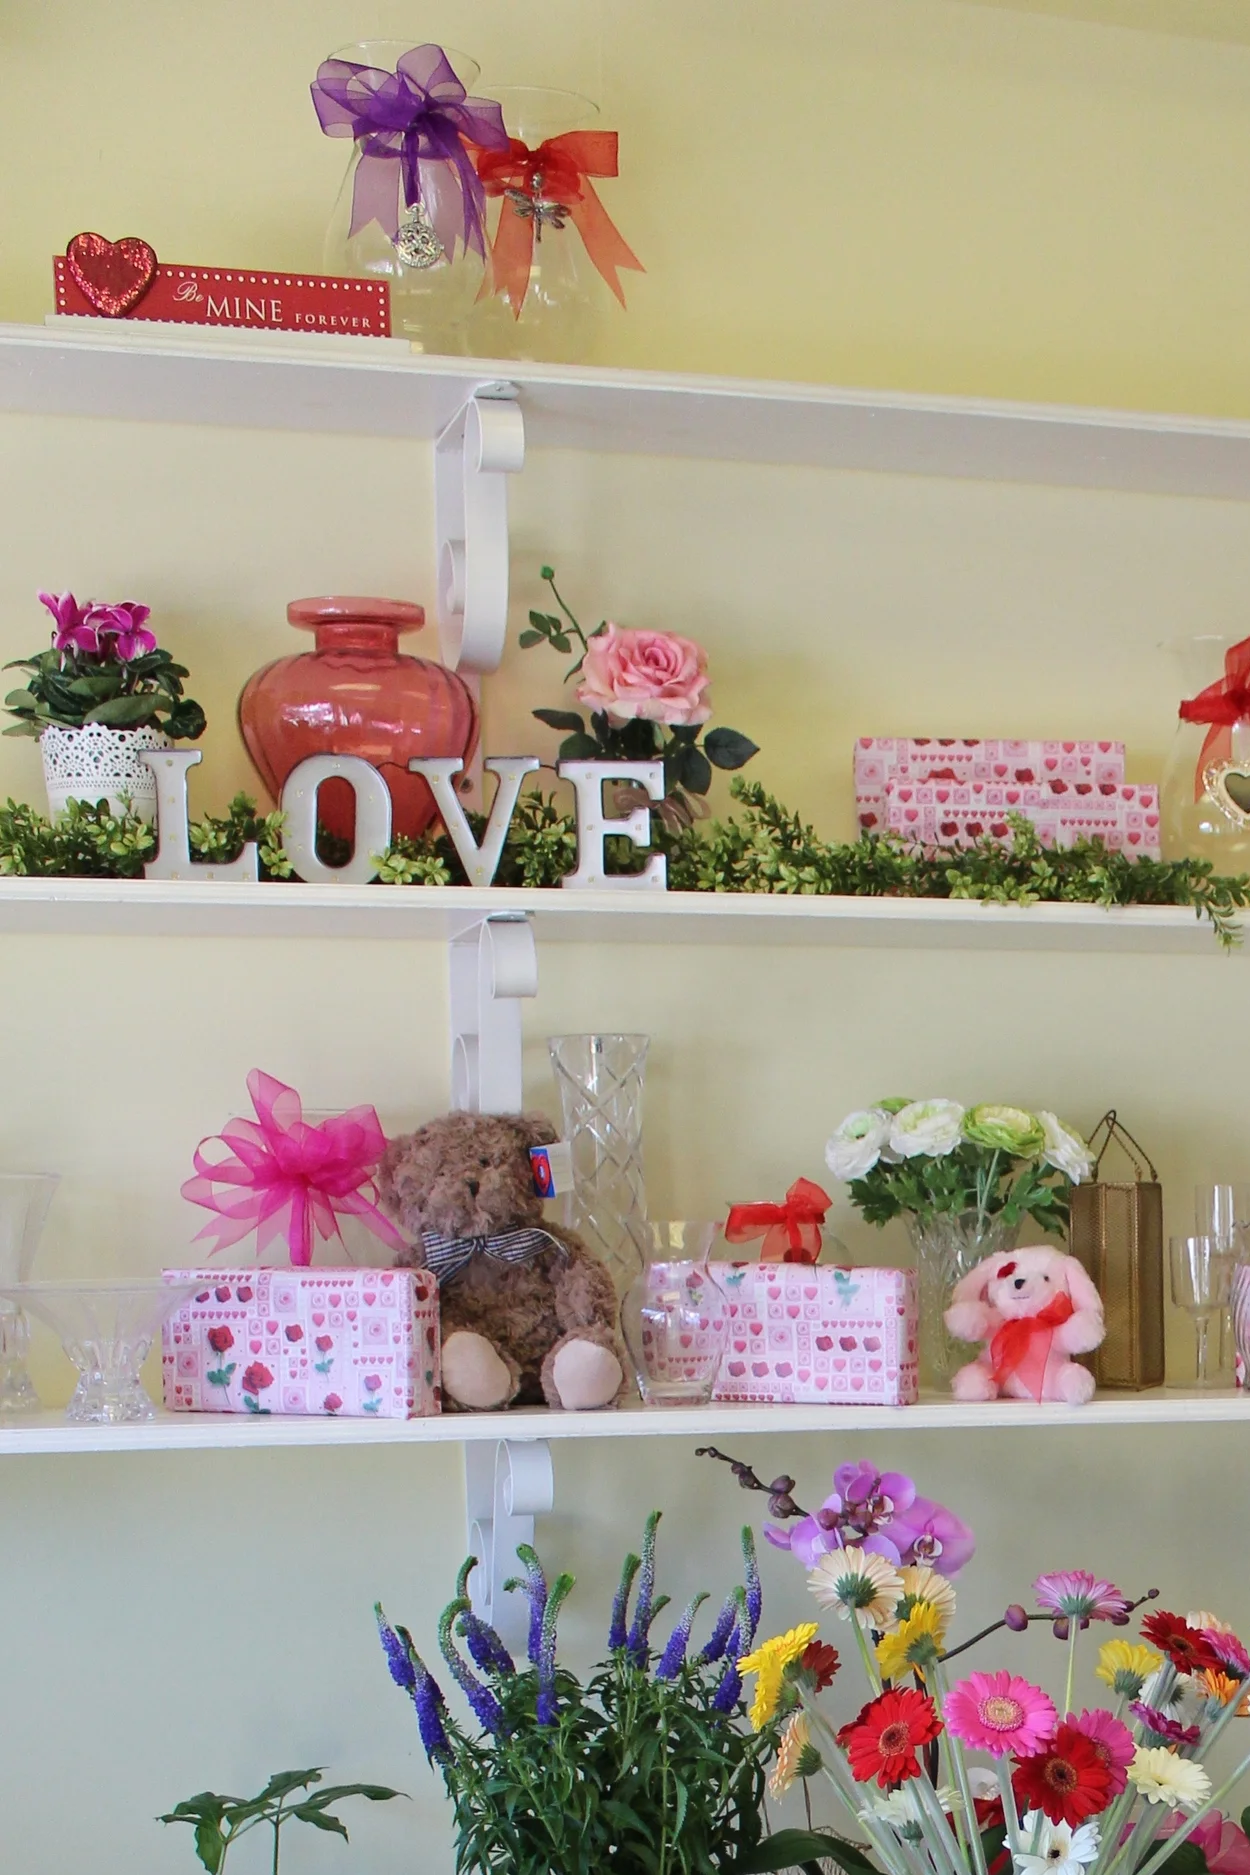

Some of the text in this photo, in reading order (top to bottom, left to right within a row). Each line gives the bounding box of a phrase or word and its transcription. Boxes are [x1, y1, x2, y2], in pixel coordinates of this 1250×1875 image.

[172, 281, 371, 328] Be MINE FOREVER
[138, 748, 668, 892] LOVE
